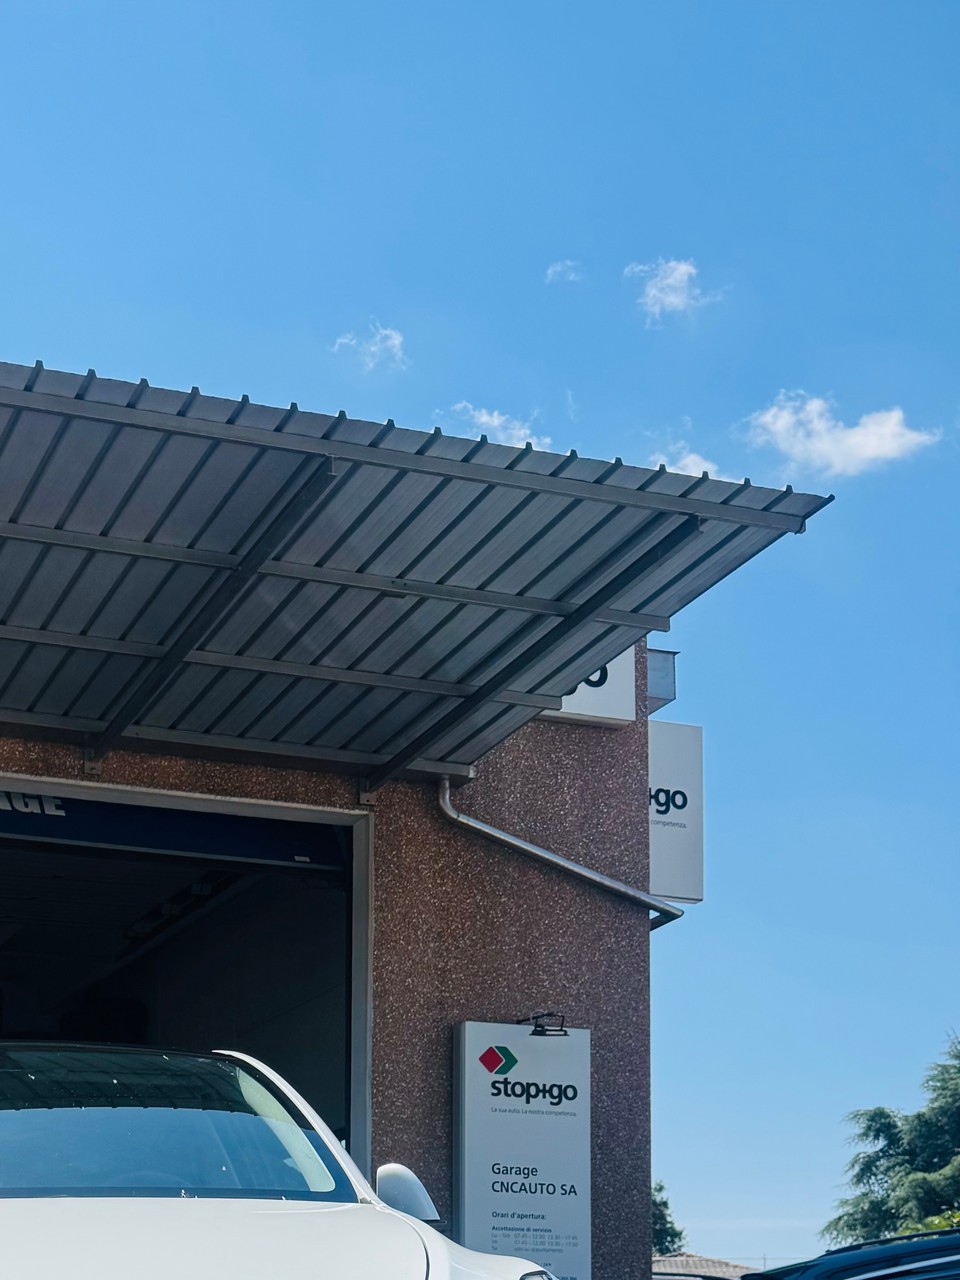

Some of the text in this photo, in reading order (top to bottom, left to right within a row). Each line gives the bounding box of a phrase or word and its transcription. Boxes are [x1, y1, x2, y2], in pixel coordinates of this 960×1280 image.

[491, 1077, 578, 1106] stop+go
[491, 1162, 538, 1179] Garage
[491, 1181, 578, 1196] CNCAUTO SA
